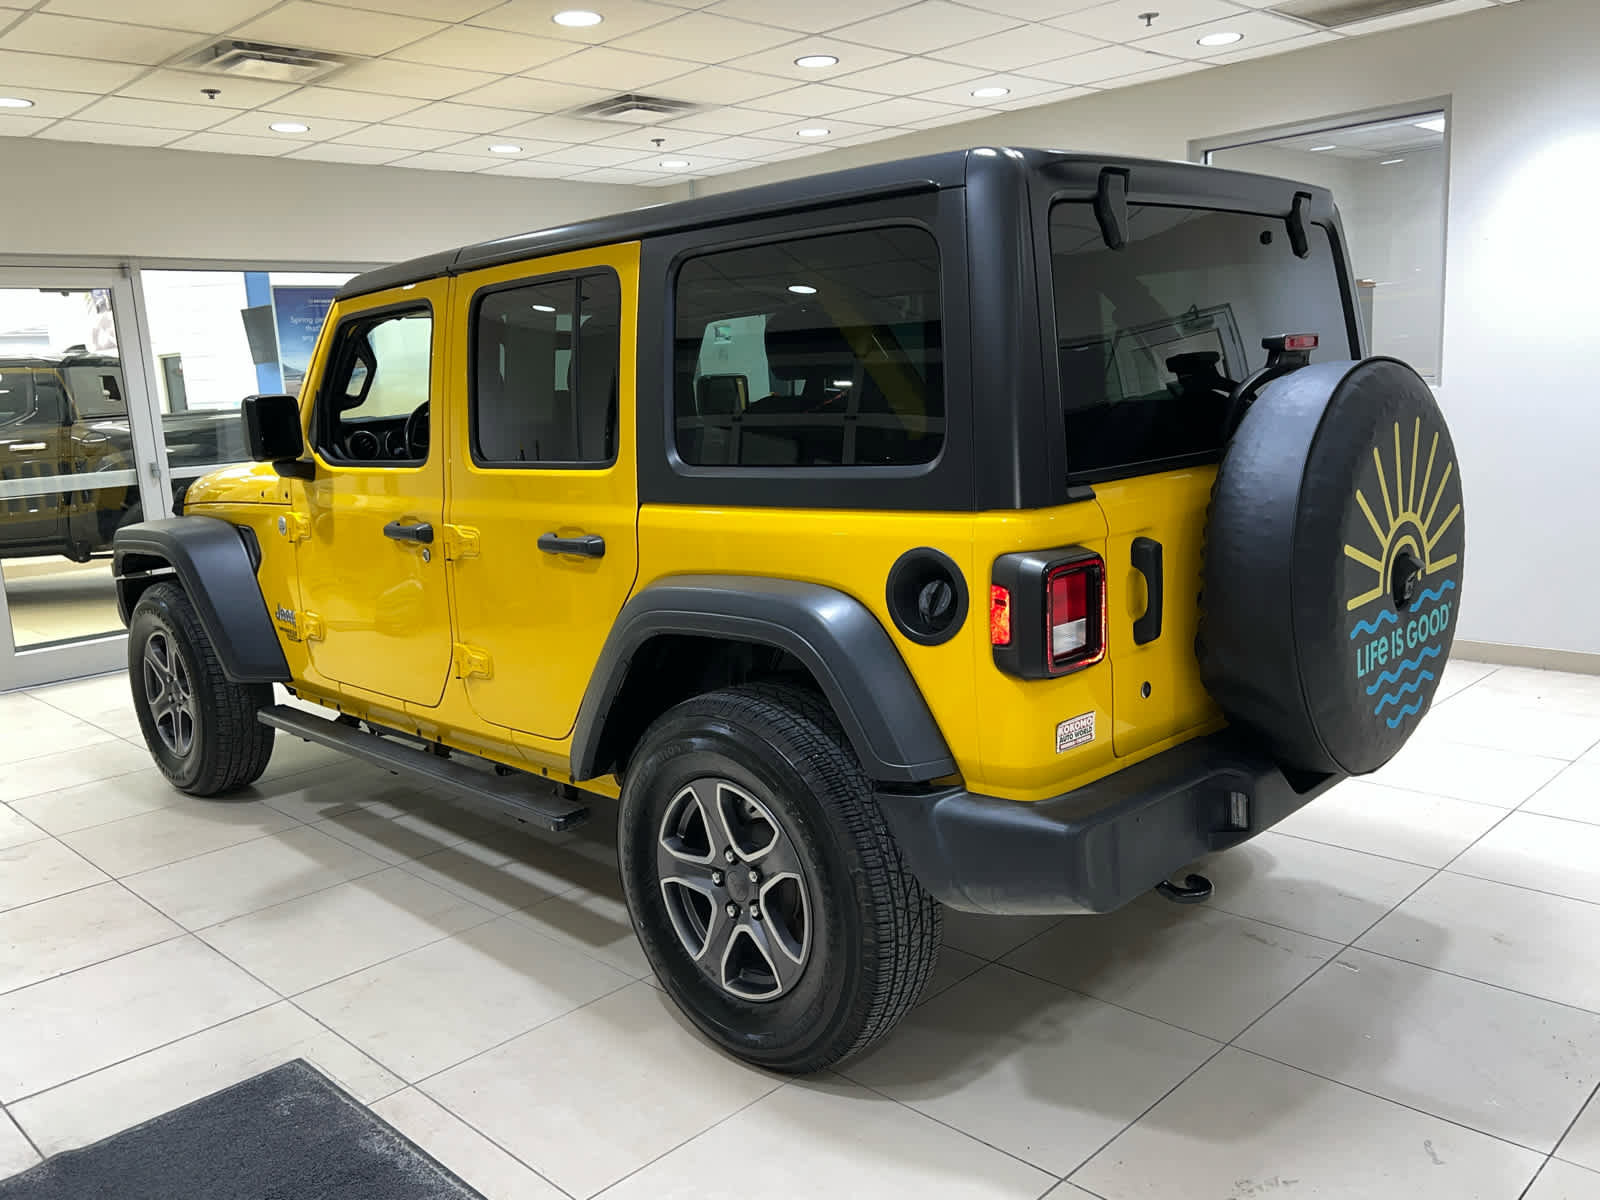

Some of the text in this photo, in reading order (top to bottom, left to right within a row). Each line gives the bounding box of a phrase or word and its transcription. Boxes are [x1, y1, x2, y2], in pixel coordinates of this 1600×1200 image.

[1059, 716, 1093, 736] KOKOMO
[1060, 734, 1073, 743] AUTO
[1074, 727, 1093, 738] WORLD
